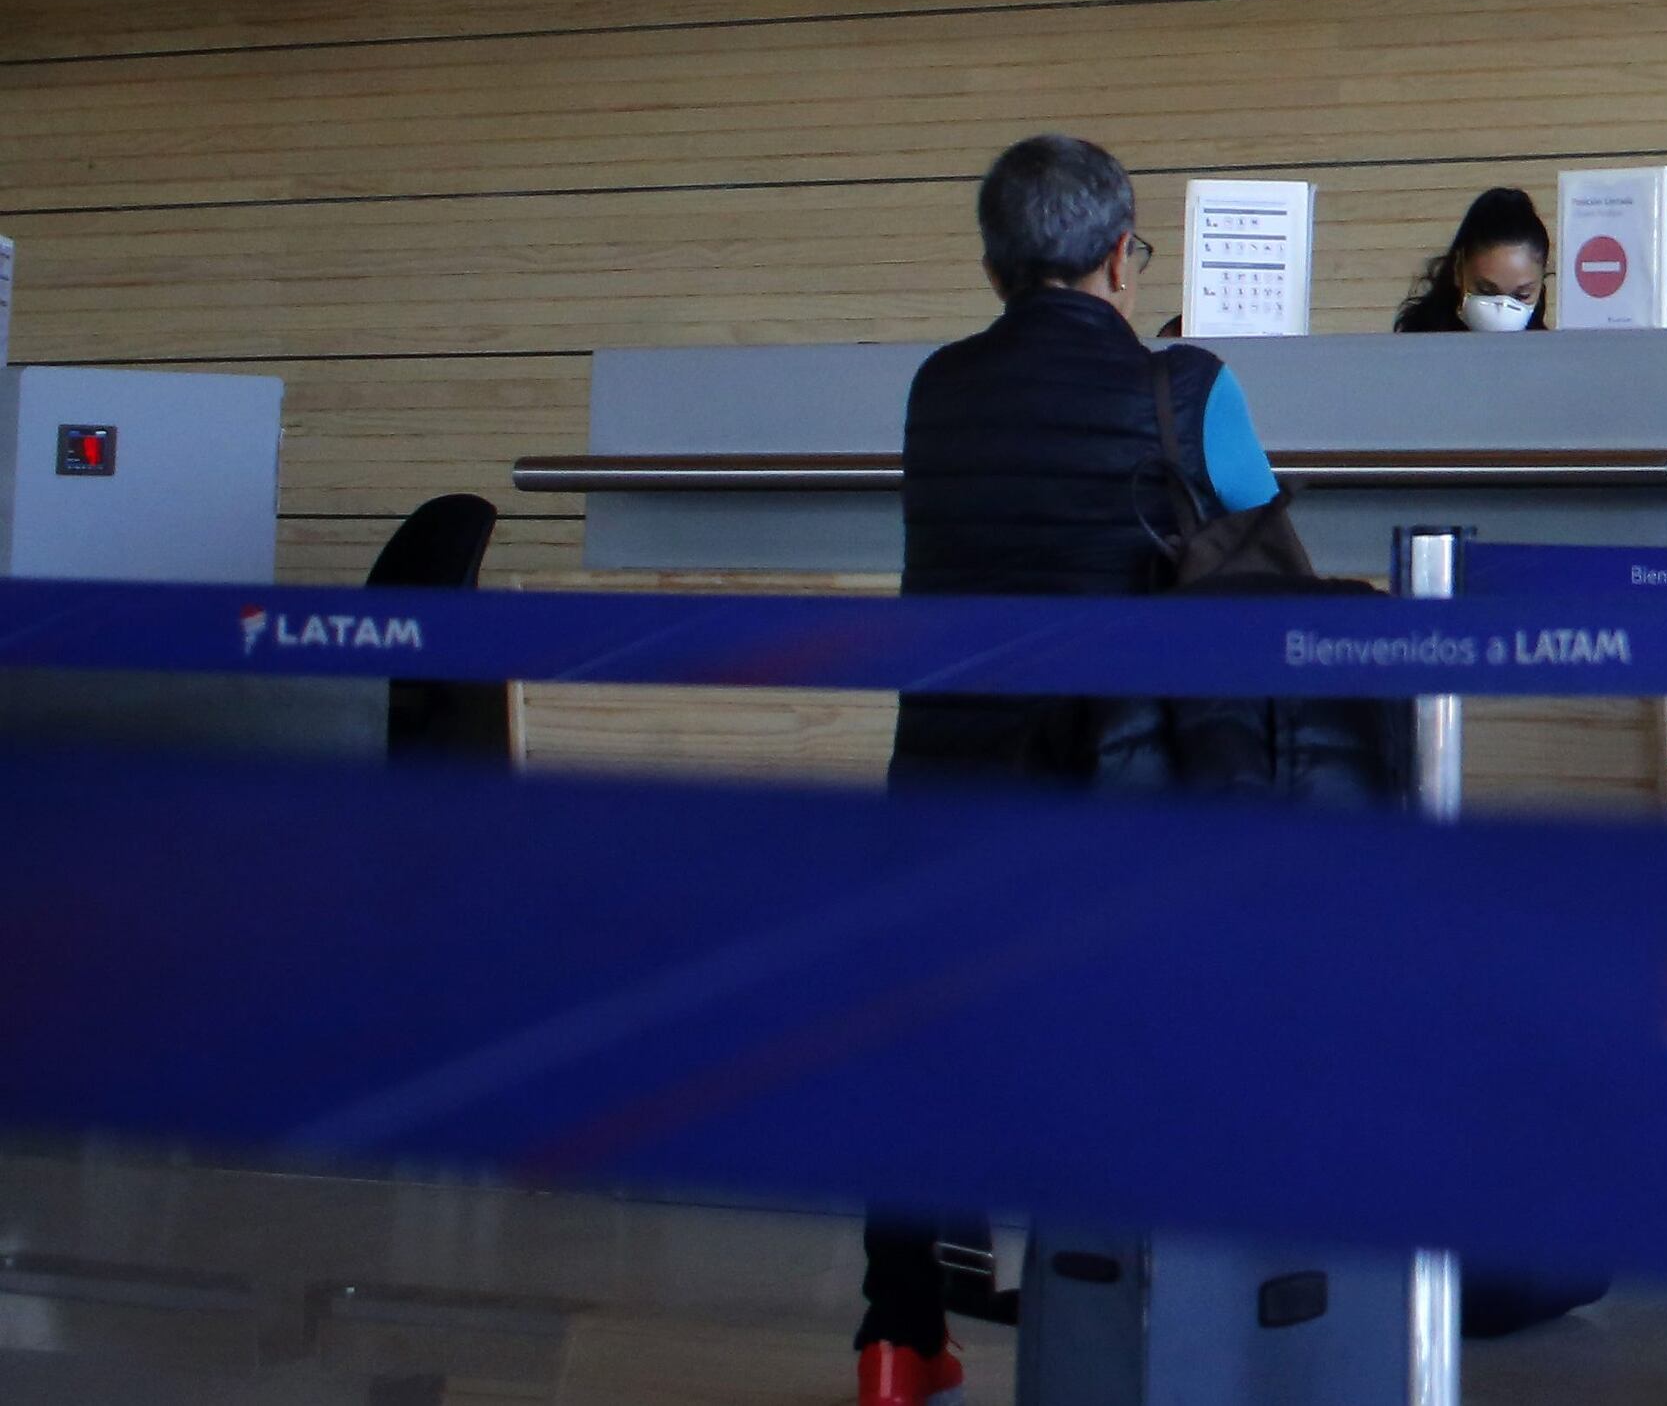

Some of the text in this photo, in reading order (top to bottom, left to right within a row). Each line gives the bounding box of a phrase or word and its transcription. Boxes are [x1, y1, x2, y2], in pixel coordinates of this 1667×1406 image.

[277, 613, 424, 651] LATAM
[1285, 627, 1633, 667] Bienvenidos a LATAM
